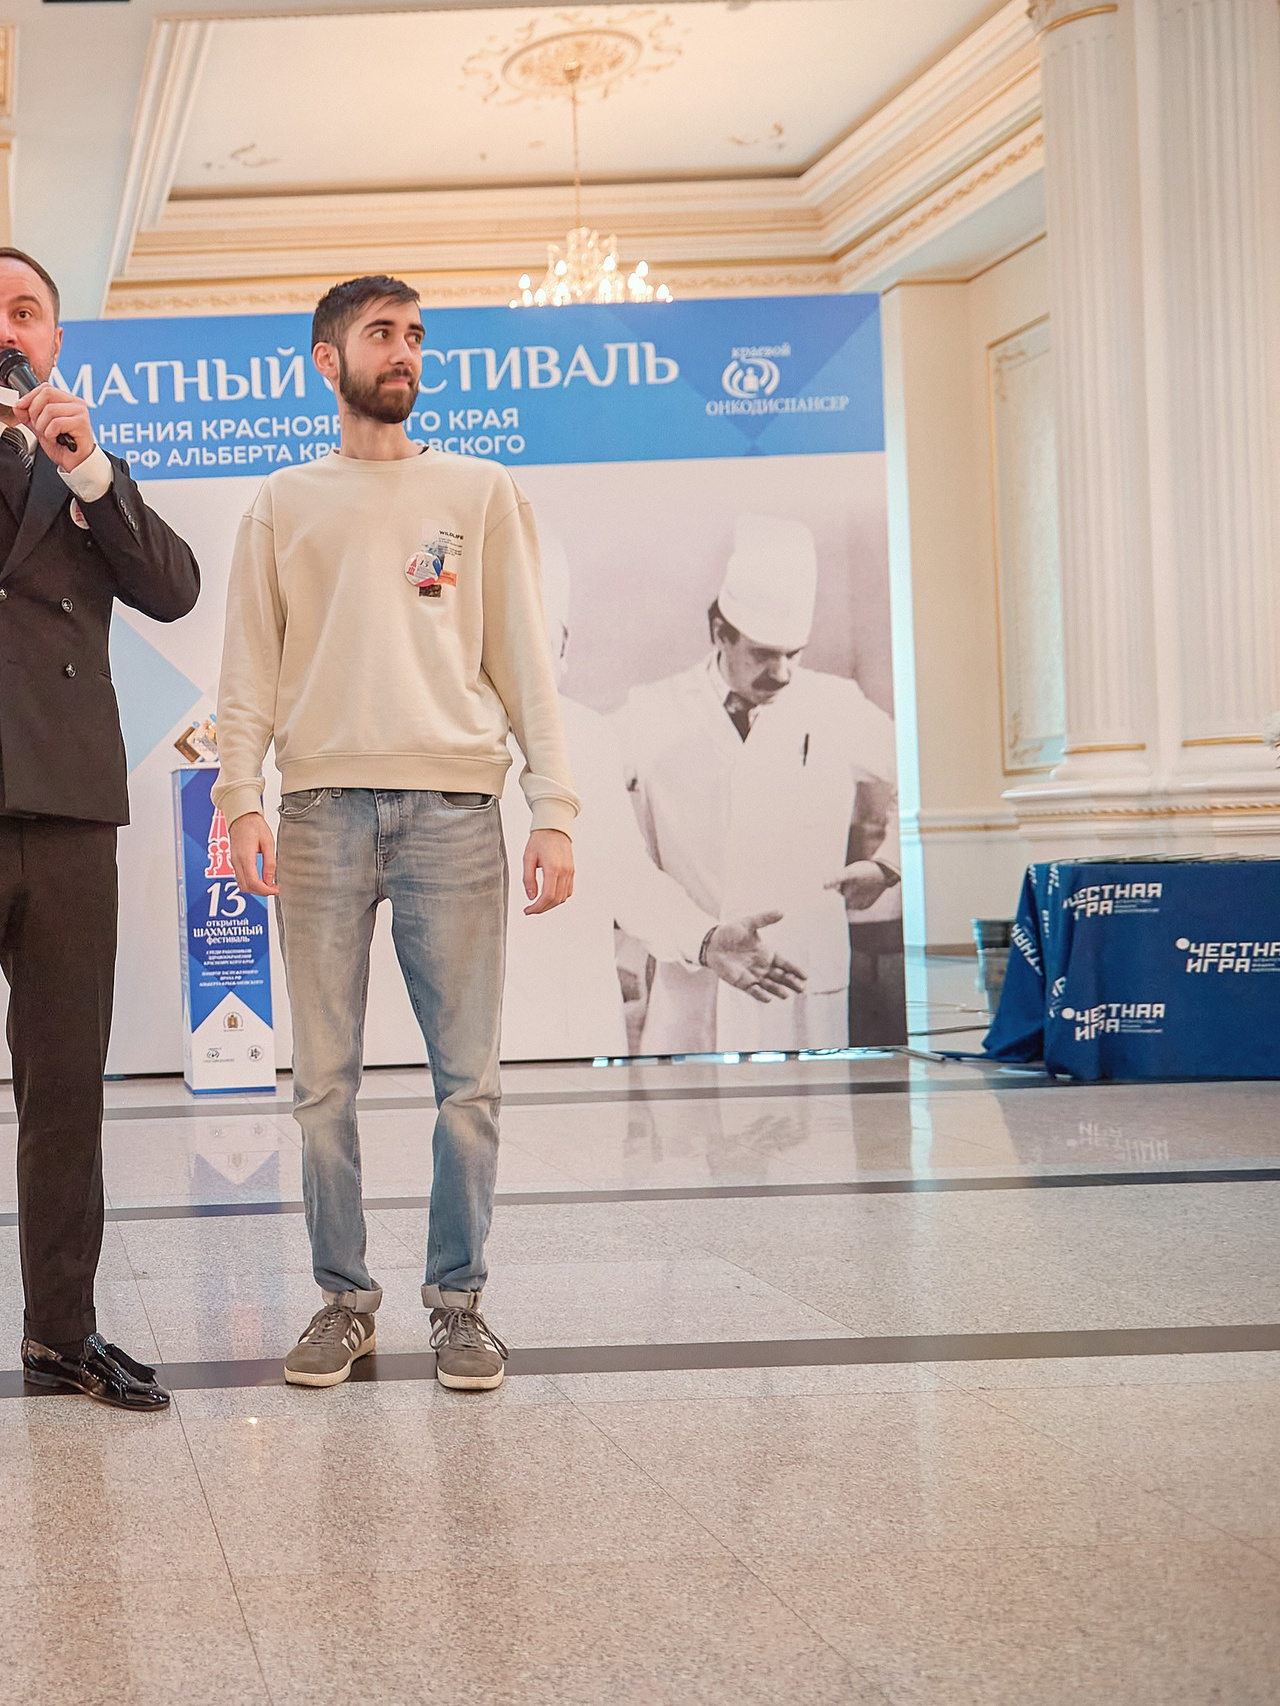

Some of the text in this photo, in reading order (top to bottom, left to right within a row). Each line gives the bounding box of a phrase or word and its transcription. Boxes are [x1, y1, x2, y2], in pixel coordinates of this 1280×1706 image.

[705, 395, 849, 416] ОНКОДИСПАНСЕР
[98, 419, 193, 445] НЕНИЯ
[202, 409, 441, 441] КРАСНОЯРГО
[448, 407, 519, 431] КРАЯ
[126, 448, 160, 468] РФ
[167, 443, 293, 467] АЛЬБЕРТА
[206, 881, 247, 917] 13
[193, 924, 263, 938] ШАХМАТНЫЙ
[1186, 958, 1250, 973] ИГРА
